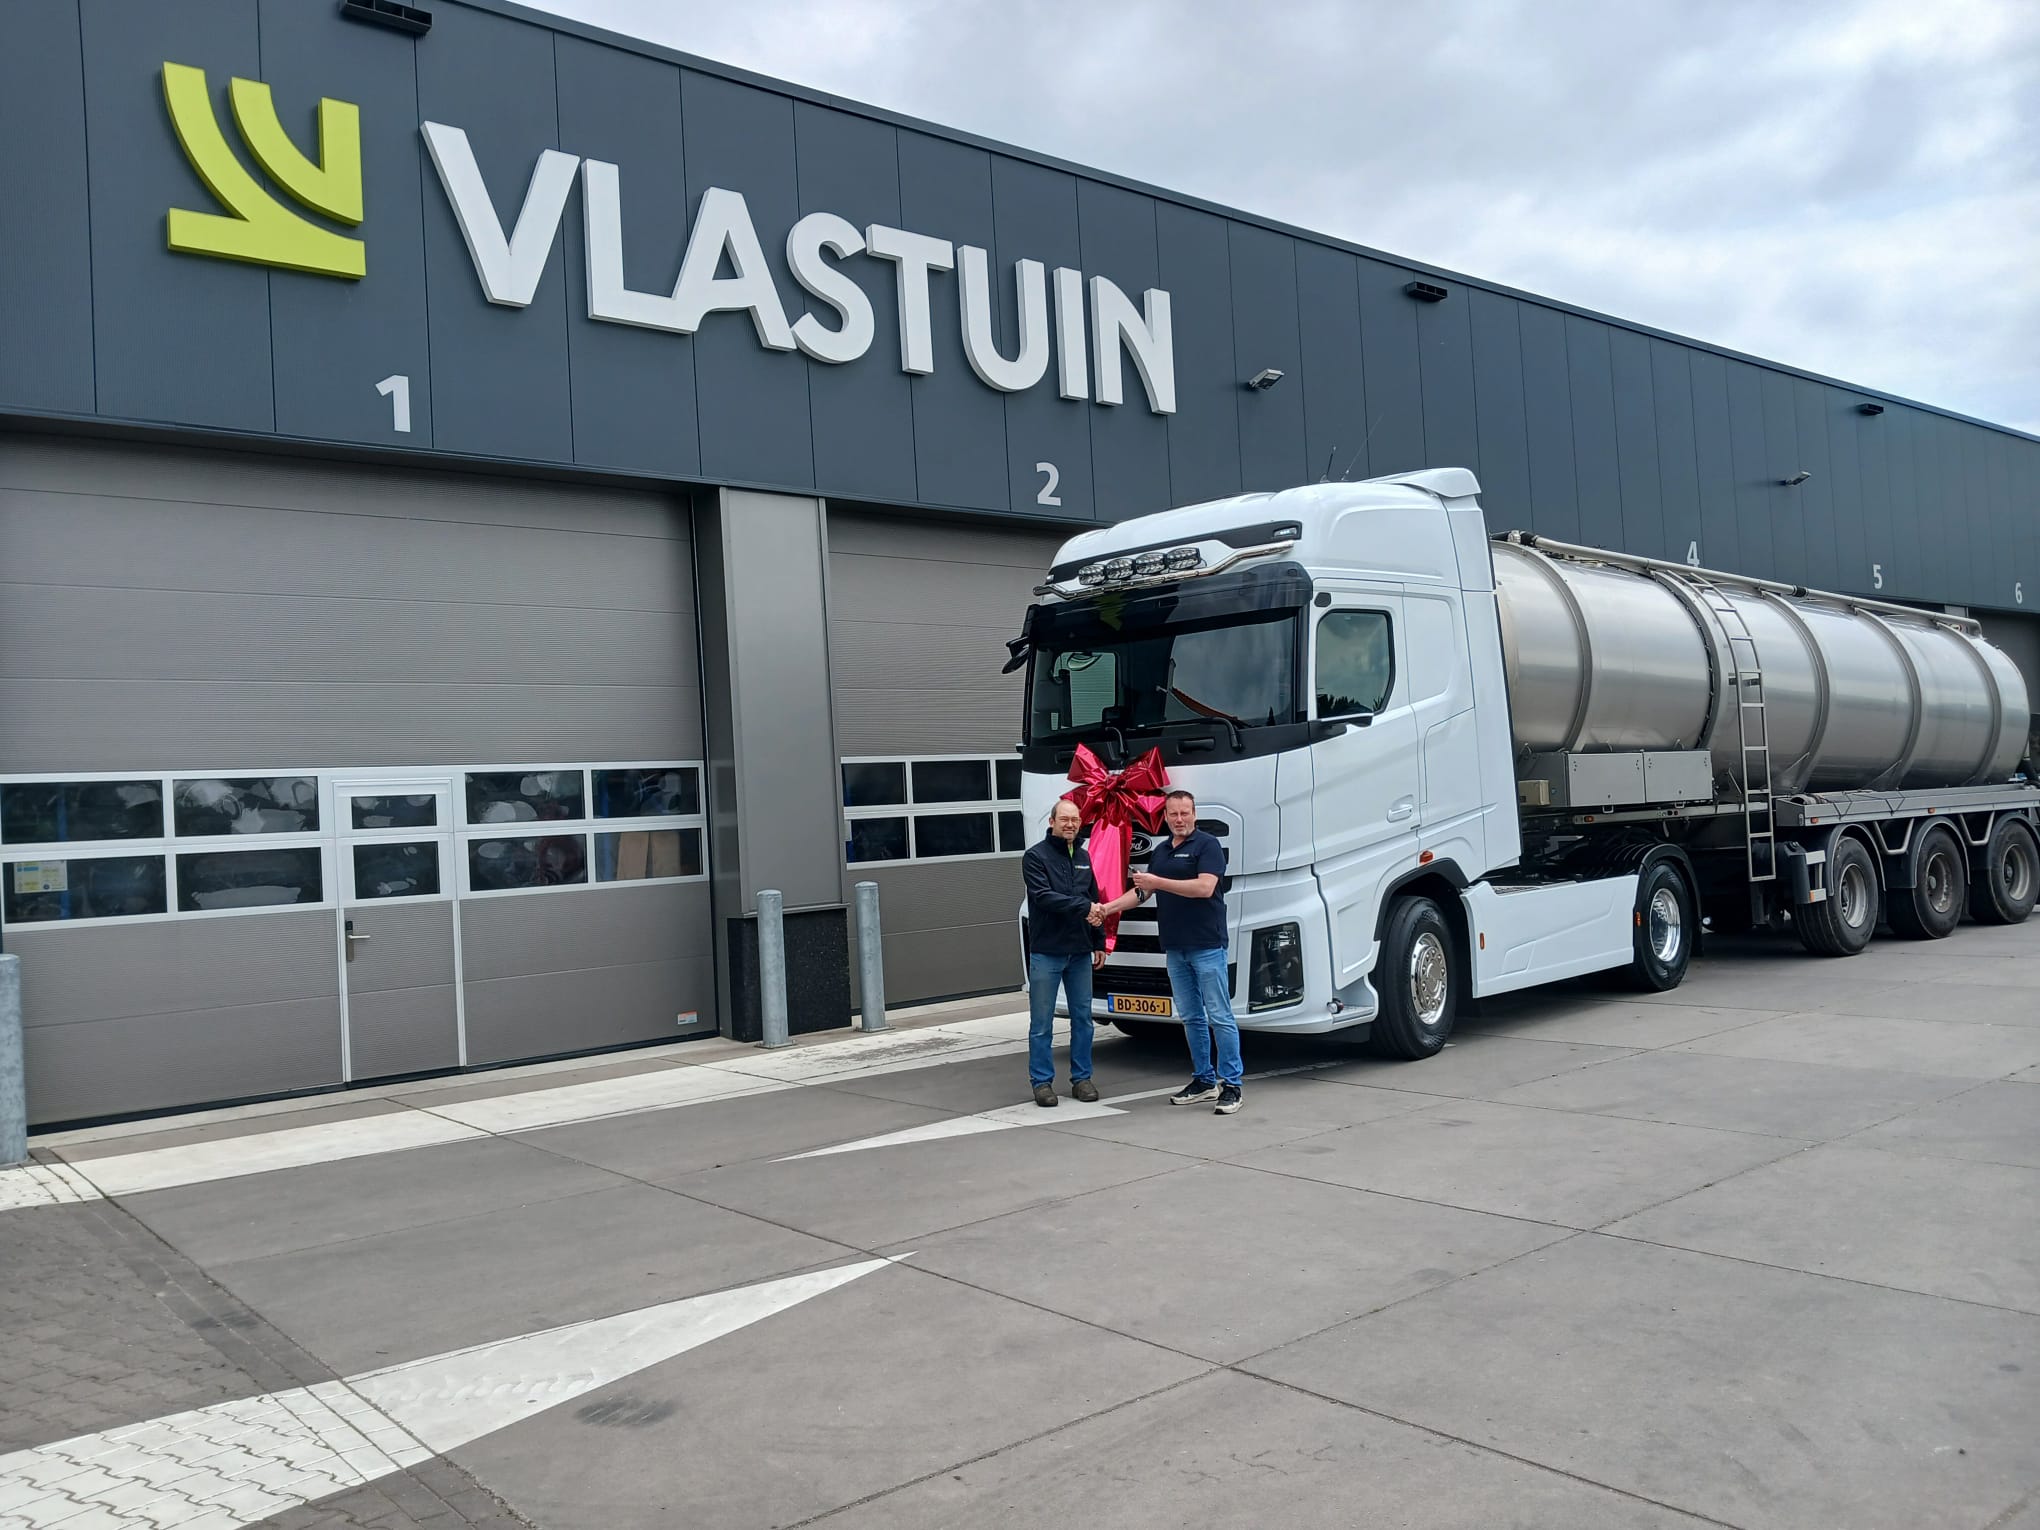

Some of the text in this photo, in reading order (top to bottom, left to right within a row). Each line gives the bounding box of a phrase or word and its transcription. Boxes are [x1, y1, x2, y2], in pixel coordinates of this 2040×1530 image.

[421, 121, 1177, 415] VLASTUIN
[375, 375, 411, 432] 1
[1036, 462, 1061, 506] 2
[1687, 541, 1700, 568] 4
[1873, 564, 1883, 589] 5
[2015, 582, 2023, 604] 6
[1117, 998, 1166, 1013] BD-306-J
